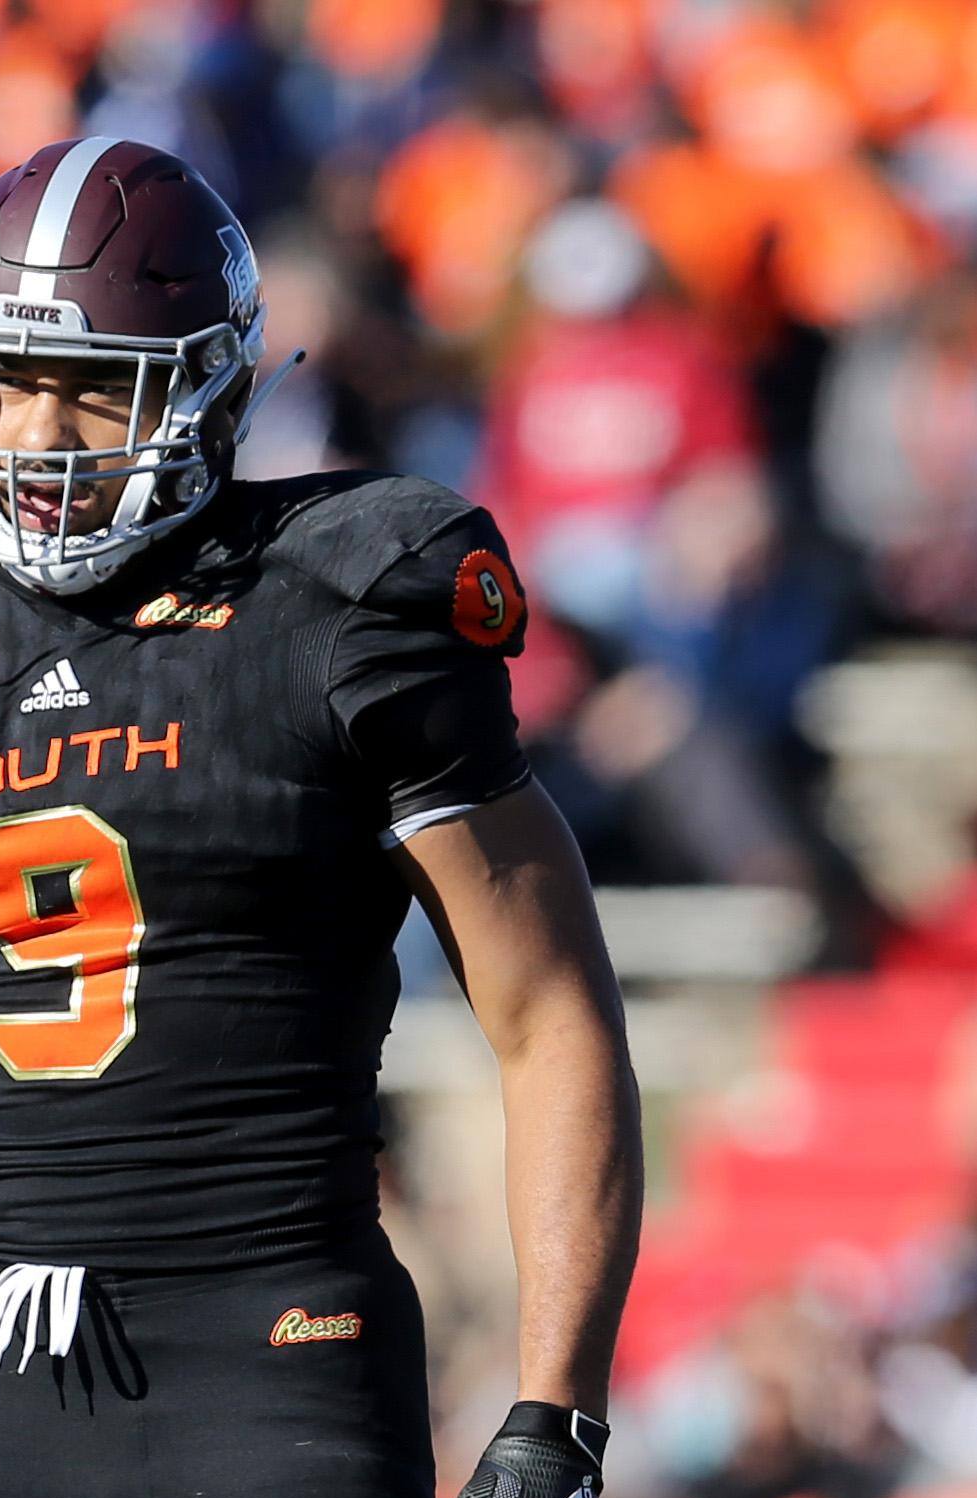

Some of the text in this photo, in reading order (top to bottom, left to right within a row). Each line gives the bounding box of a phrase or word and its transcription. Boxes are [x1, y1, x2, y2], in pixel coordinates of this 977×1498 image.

[2, 302, 62, 325] STATE
[479, 571, 504, 628] 9
[20, 689, 91, 714] adidas
[273, 1310, 359, 1343] Reese's
